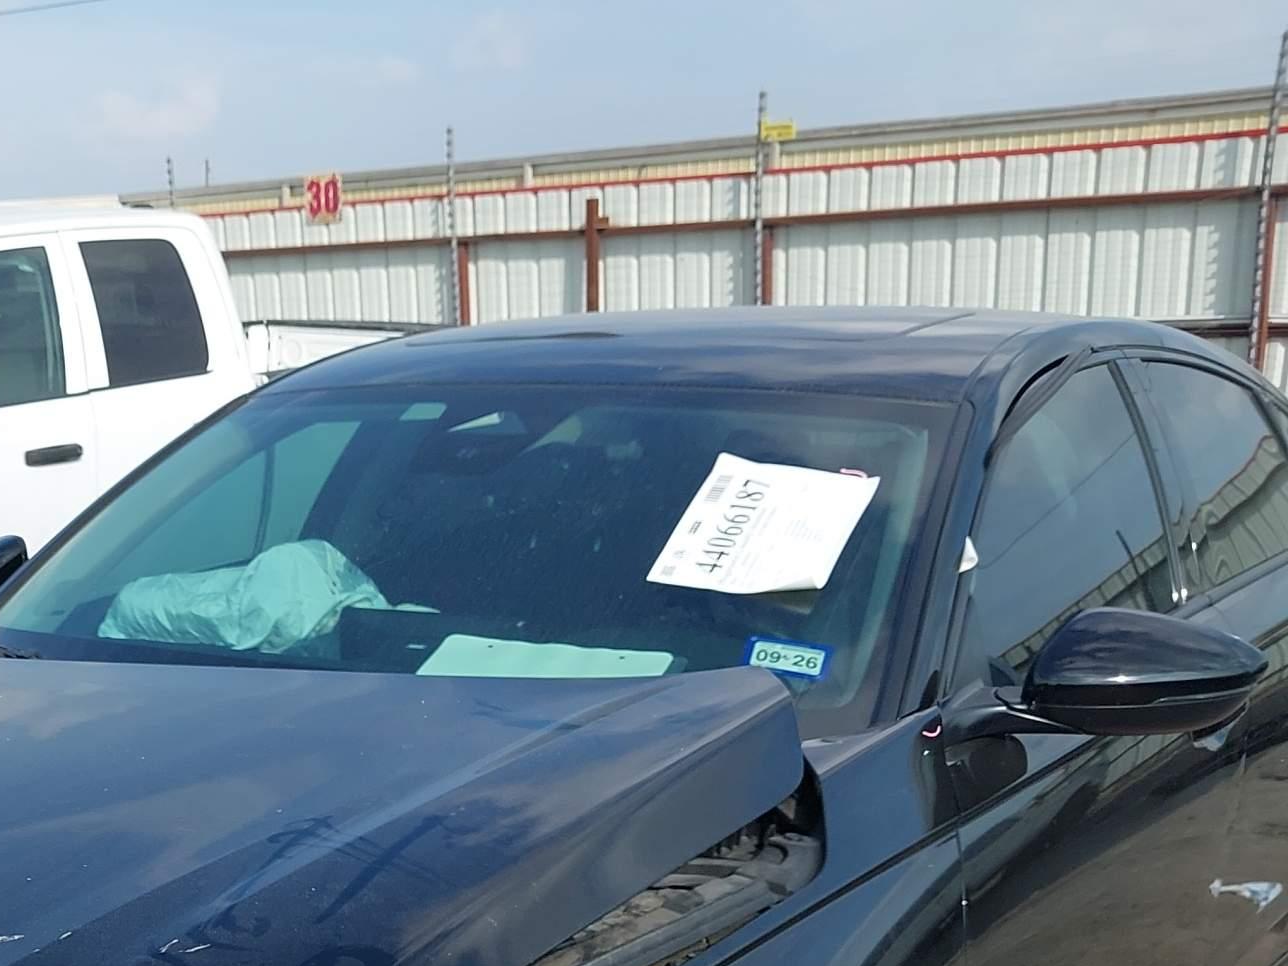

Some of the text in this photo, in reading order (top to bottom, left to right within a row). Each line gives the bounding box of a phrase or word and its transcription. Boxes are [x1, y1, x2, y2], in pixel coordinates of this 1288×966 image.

[306, 179, 340, 217] 30
[695, 478, 771, 574] 44066187
[755, 648, 819, 670] 09 26
